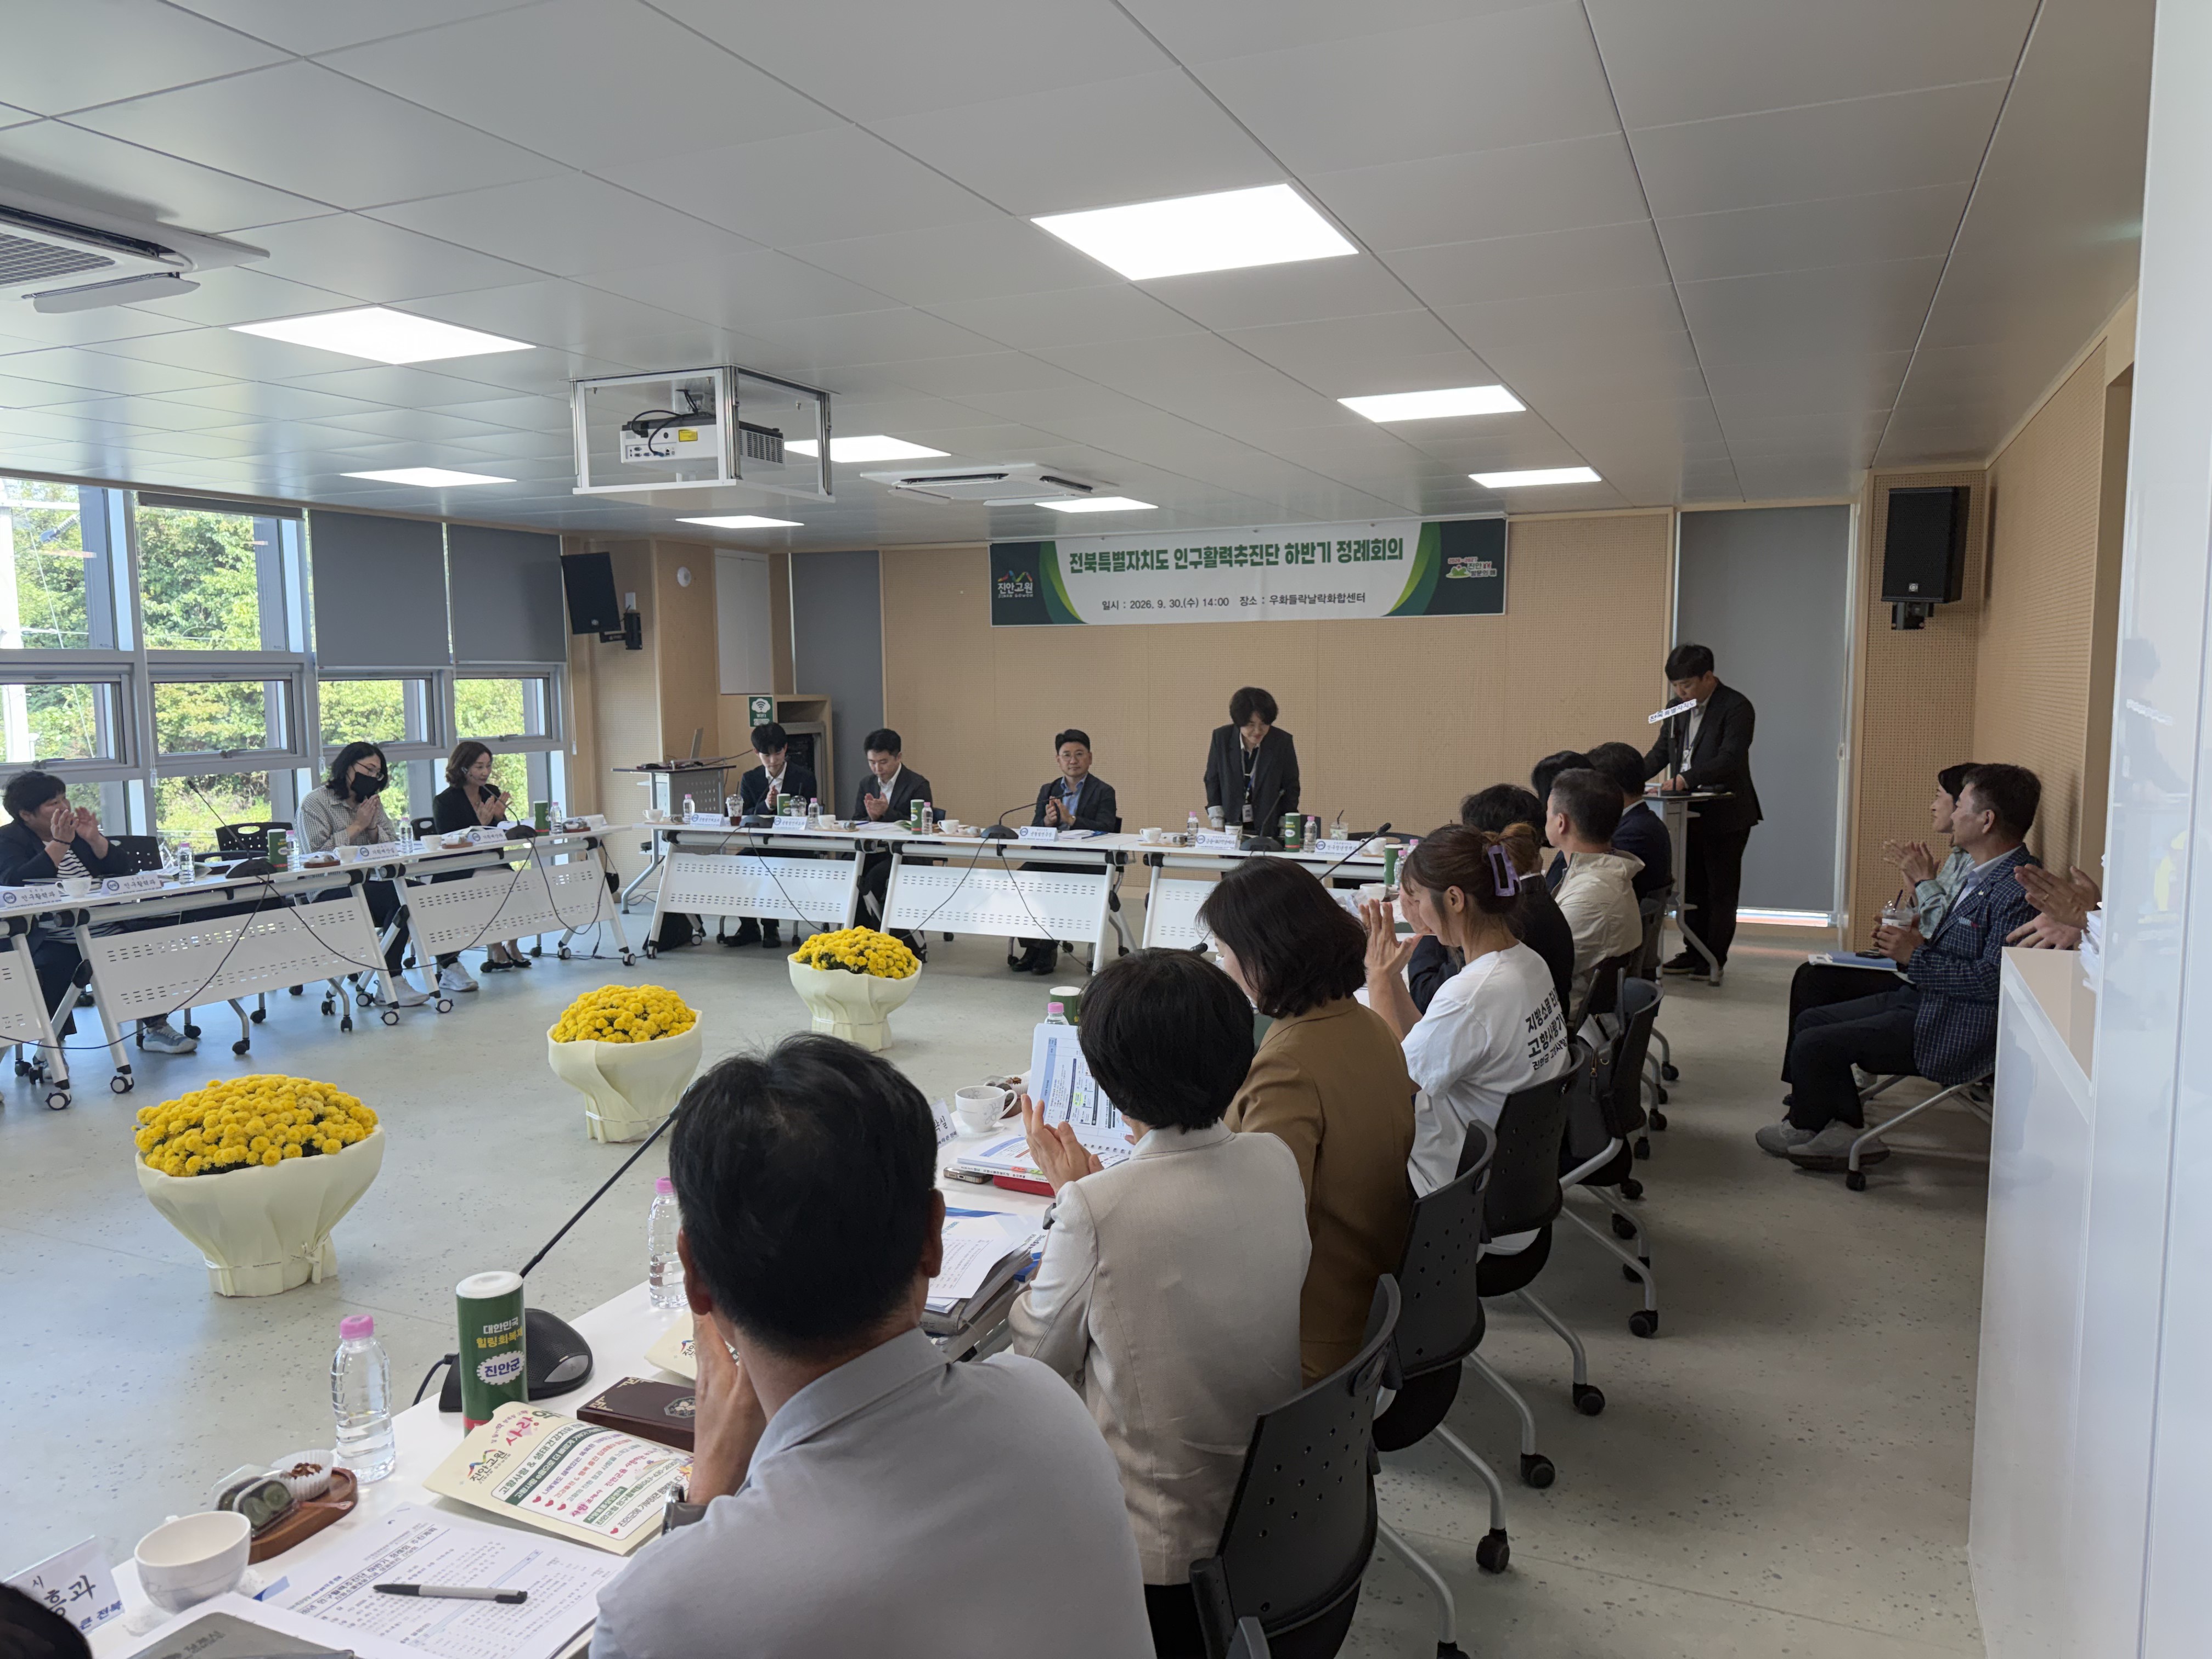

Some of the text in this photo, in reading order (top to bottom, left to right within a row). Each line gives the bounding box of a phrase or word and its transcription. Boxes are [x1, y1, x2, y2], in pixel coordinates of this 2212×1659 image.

[1069, 538, 1403, 573] 전북특별자치도 인구활력추진단 하반기 정례회의
[998, 582, 1033, 594] 진안고원
[1102, 601, 1119, 610] 일시
[1130, 601, 1154, 609] 2026.
[1158, 601, 1166, 609] 9.
[1169, 598, 1199, 609] 30.(수)
[1203, 597, 1229, 607] 14:00
[1240, 596, 1257, 606] 장소
[1269, 592, 1365, 605] 우화들락날락화합센터
[21, 890, 55, 901] 인구활력과
[1525, 997, 1552, 1033] 지방소멸
[1528, 1012, 1566, 1058] 고향사랑기
[1532, 1036, 1567, 1070] 진안군 고향사랑
[483, 1317, 518, 1334] 대한민국
[485, 1358, 520, 1377] 진안군
[506, 1417, 539, 1446] 사랑
[470, 1451, 507, 1481] 진안고원
[498, 1468, 529, 1494] 고향사랑
[532, 1426, 573, 1460] 생태건강치유
[514, 1478, 538, 1498] 고향사랑
[569, 1503, 589, 1517] 사랑
[603, 1468, 628, 1487] 진안군을
[594, 1505, 619, 1525] 진안군청
[617, 1508, 642, 1527] 진안군에
[637, 1492, 661, 1509] 기부하면
[33, 1576, 44, 1589] 시
[80, 1600, 122, 1630] 큰 전북
